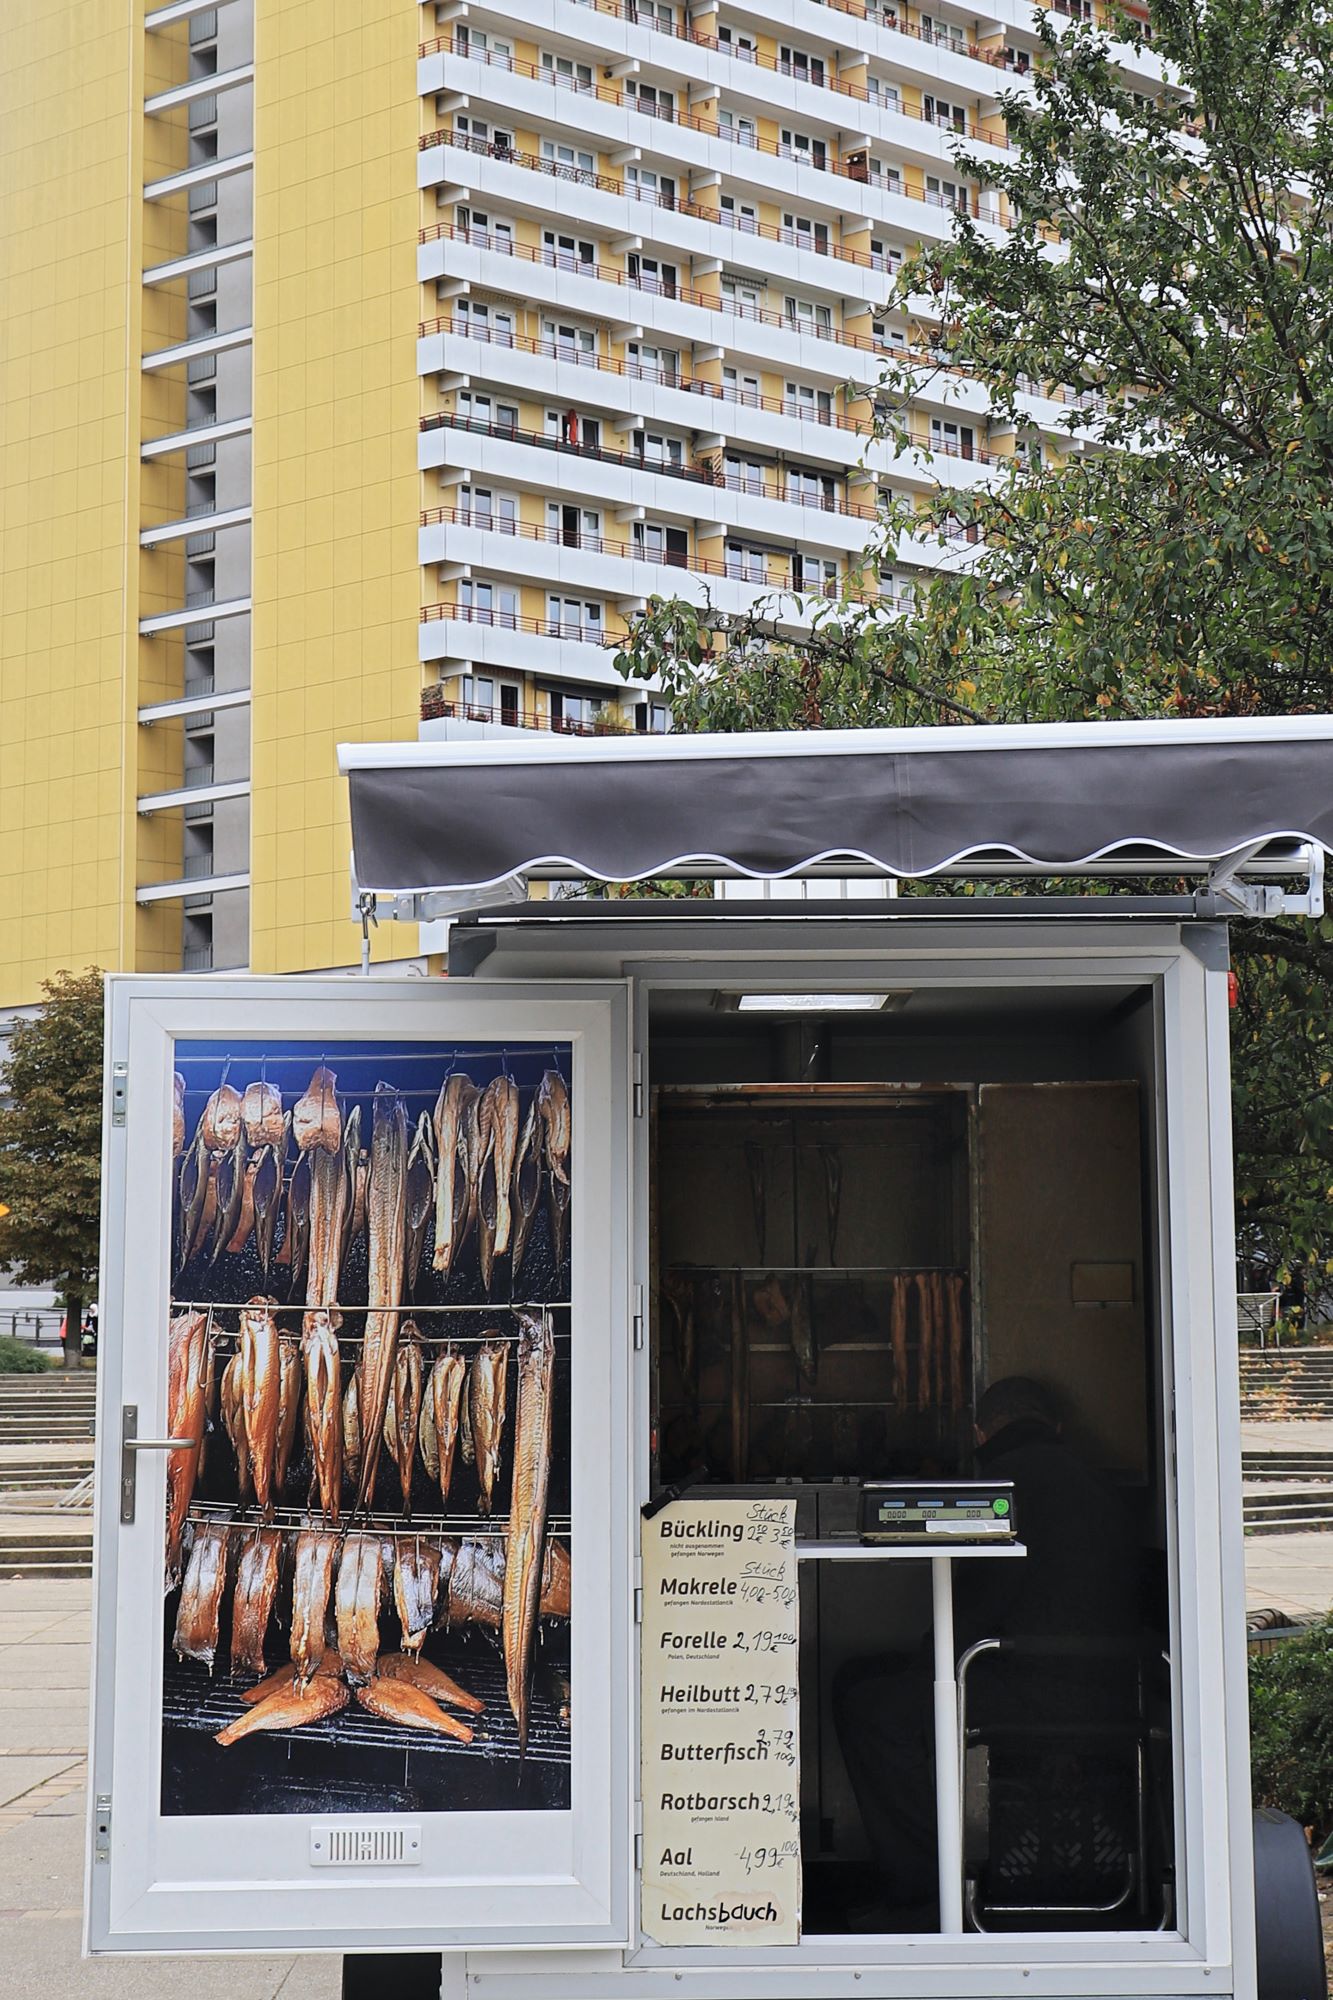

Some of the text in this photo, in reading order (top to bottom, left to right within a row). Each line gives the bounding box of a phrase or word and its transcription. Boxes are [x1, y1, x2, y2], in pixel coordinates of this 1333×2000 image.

[660, 1520, 744, 1542] Bückling
[660, 1577, 738, 1596] Makrele
[660, 1631, 728, 1649] Forelle
[660, 1685, 741, 1703] Heilbutt
[661, 1707, 687, 1715] gefangen
[660, 1742, 769, 1764] Butterfisch
[660, 1793, 760, 1811] Rotbarsch
[660, 1848, 693, 1866] Aal
[661, 1902, 778, 1923] Lachsbauch
